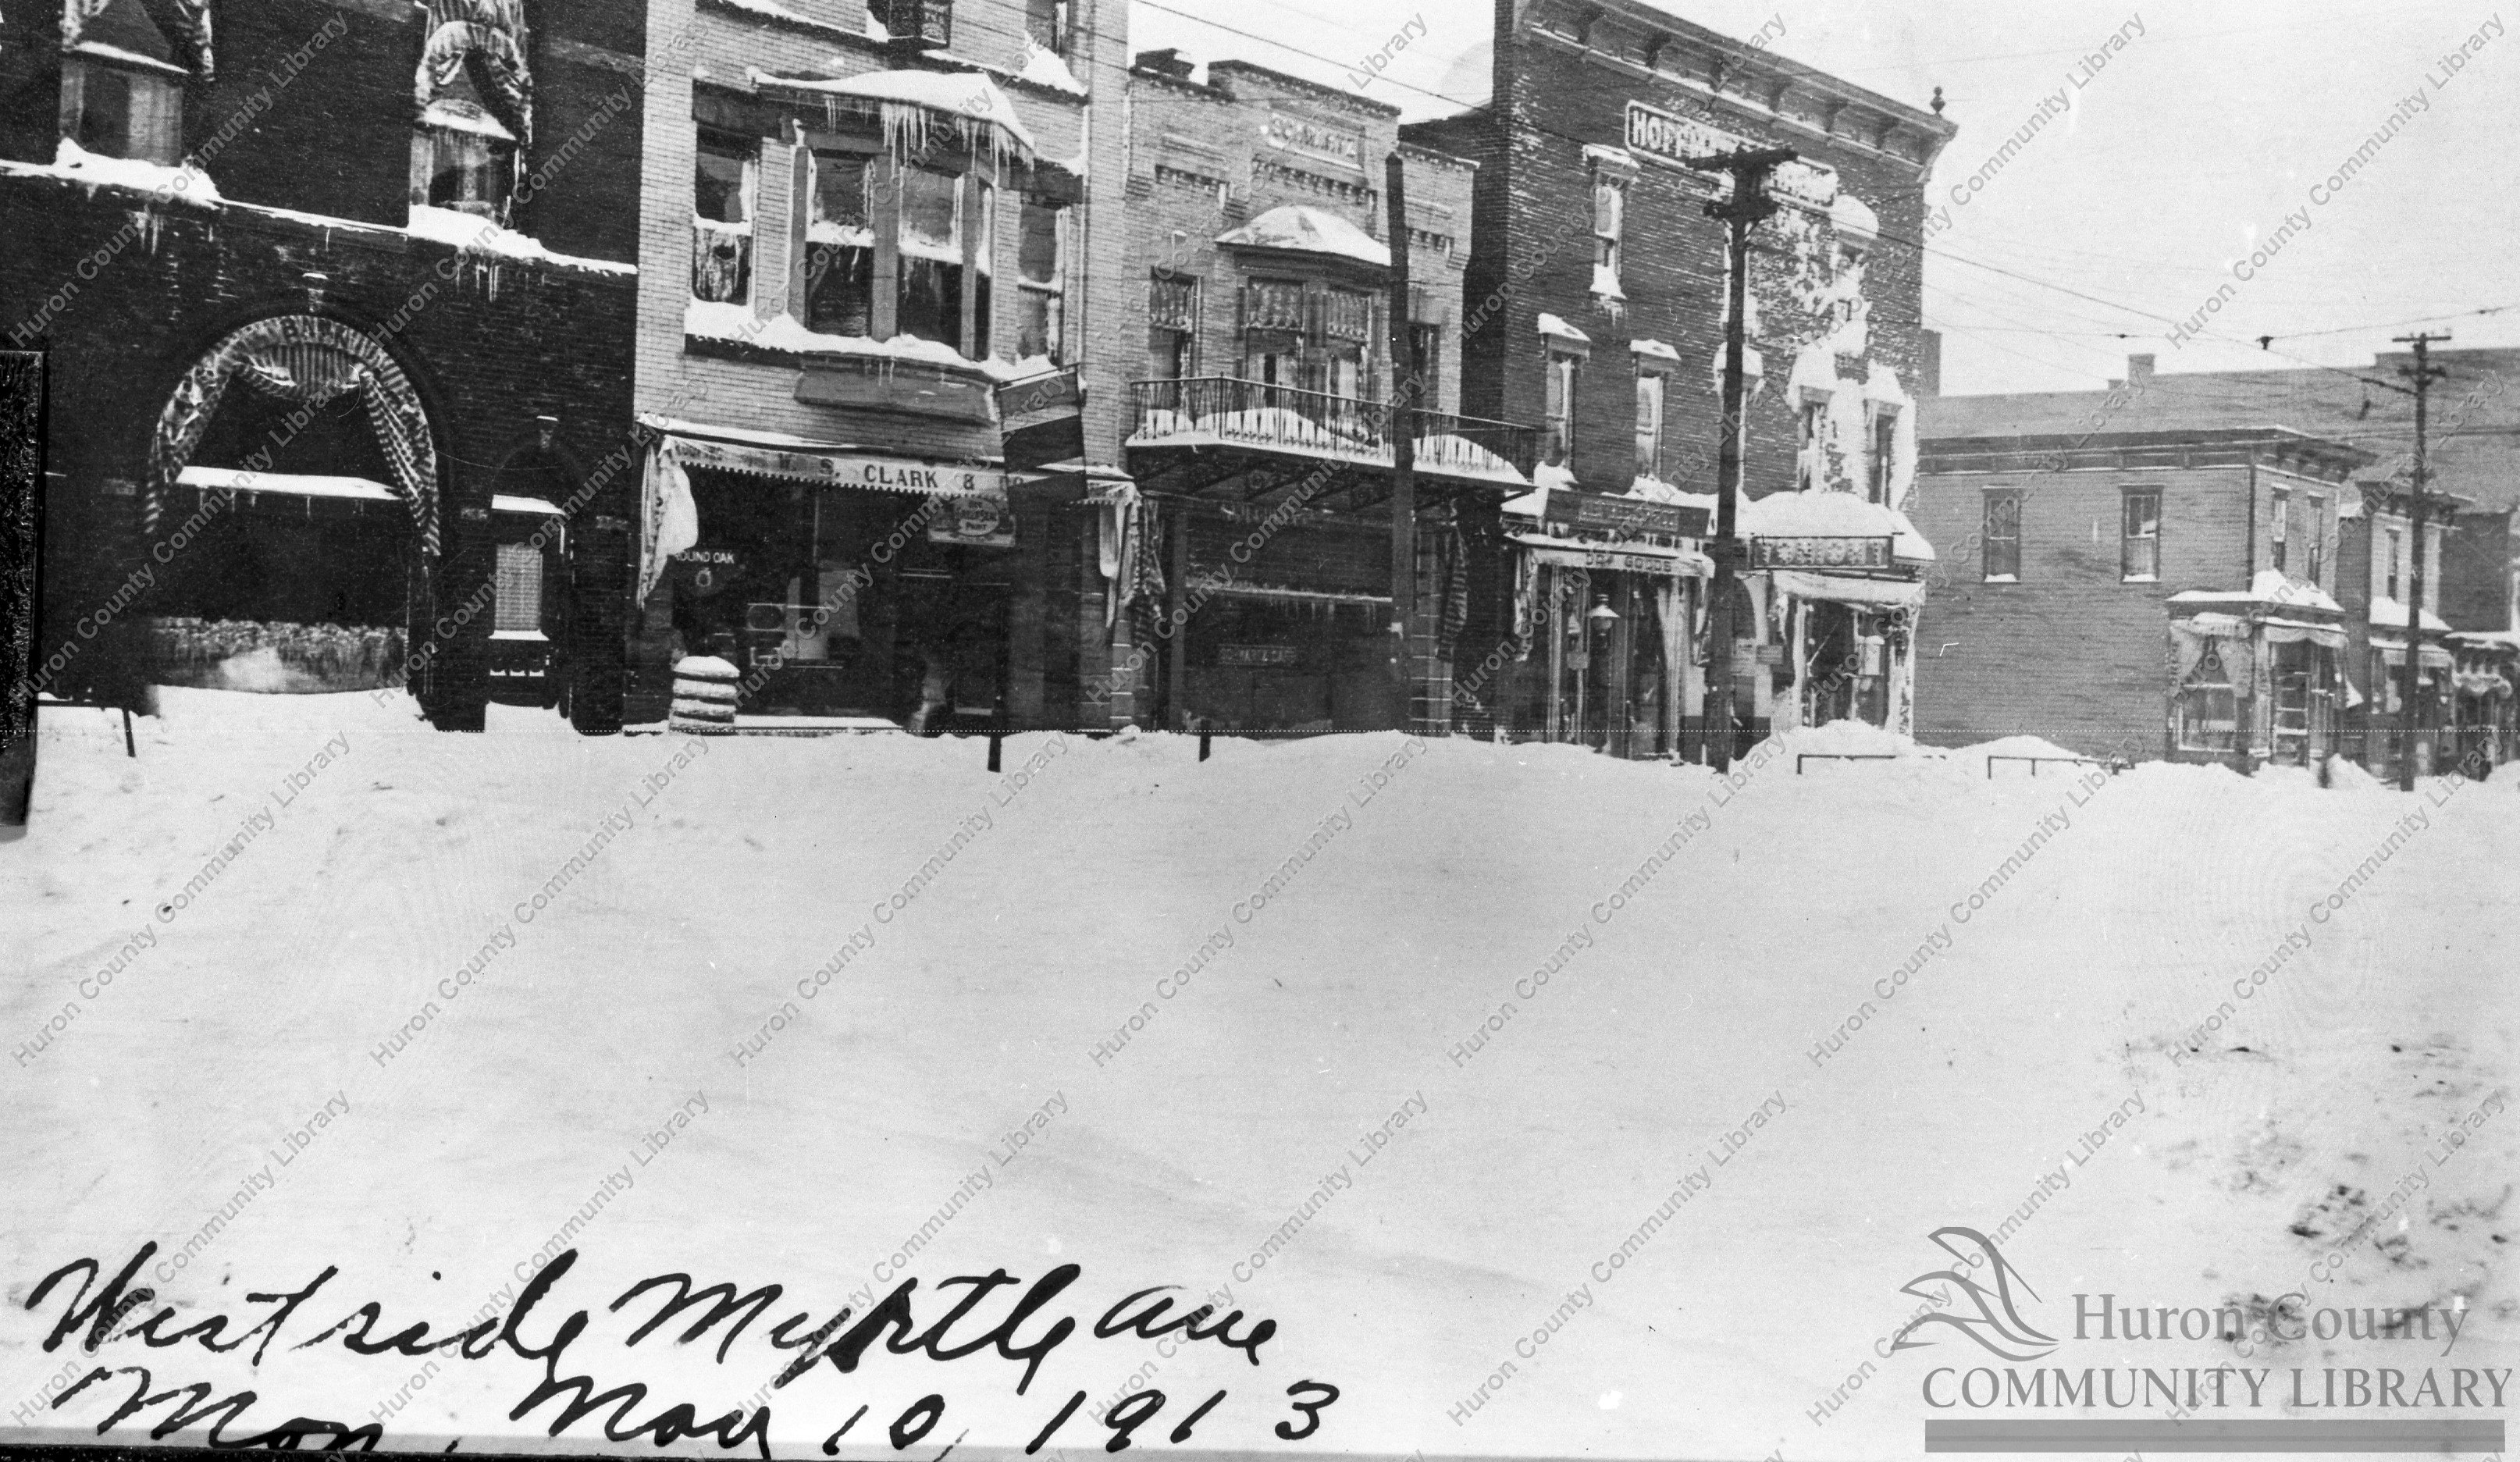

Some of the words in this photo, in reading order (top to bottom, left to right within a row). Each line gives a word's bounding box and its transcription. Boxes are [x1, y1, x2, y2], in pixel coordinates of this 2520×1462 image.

[863, 464, 938, 489] CLARK
[963, 473, 975, 490] &
[713, 552, 735, 564] OAK
[24, 1240, 339, 1367] West
[289, 1249, 589, 1382] side
[610, 1263, 1081, 1395] Myrtle
[1024, 1378, 1340, 1453] 1913
